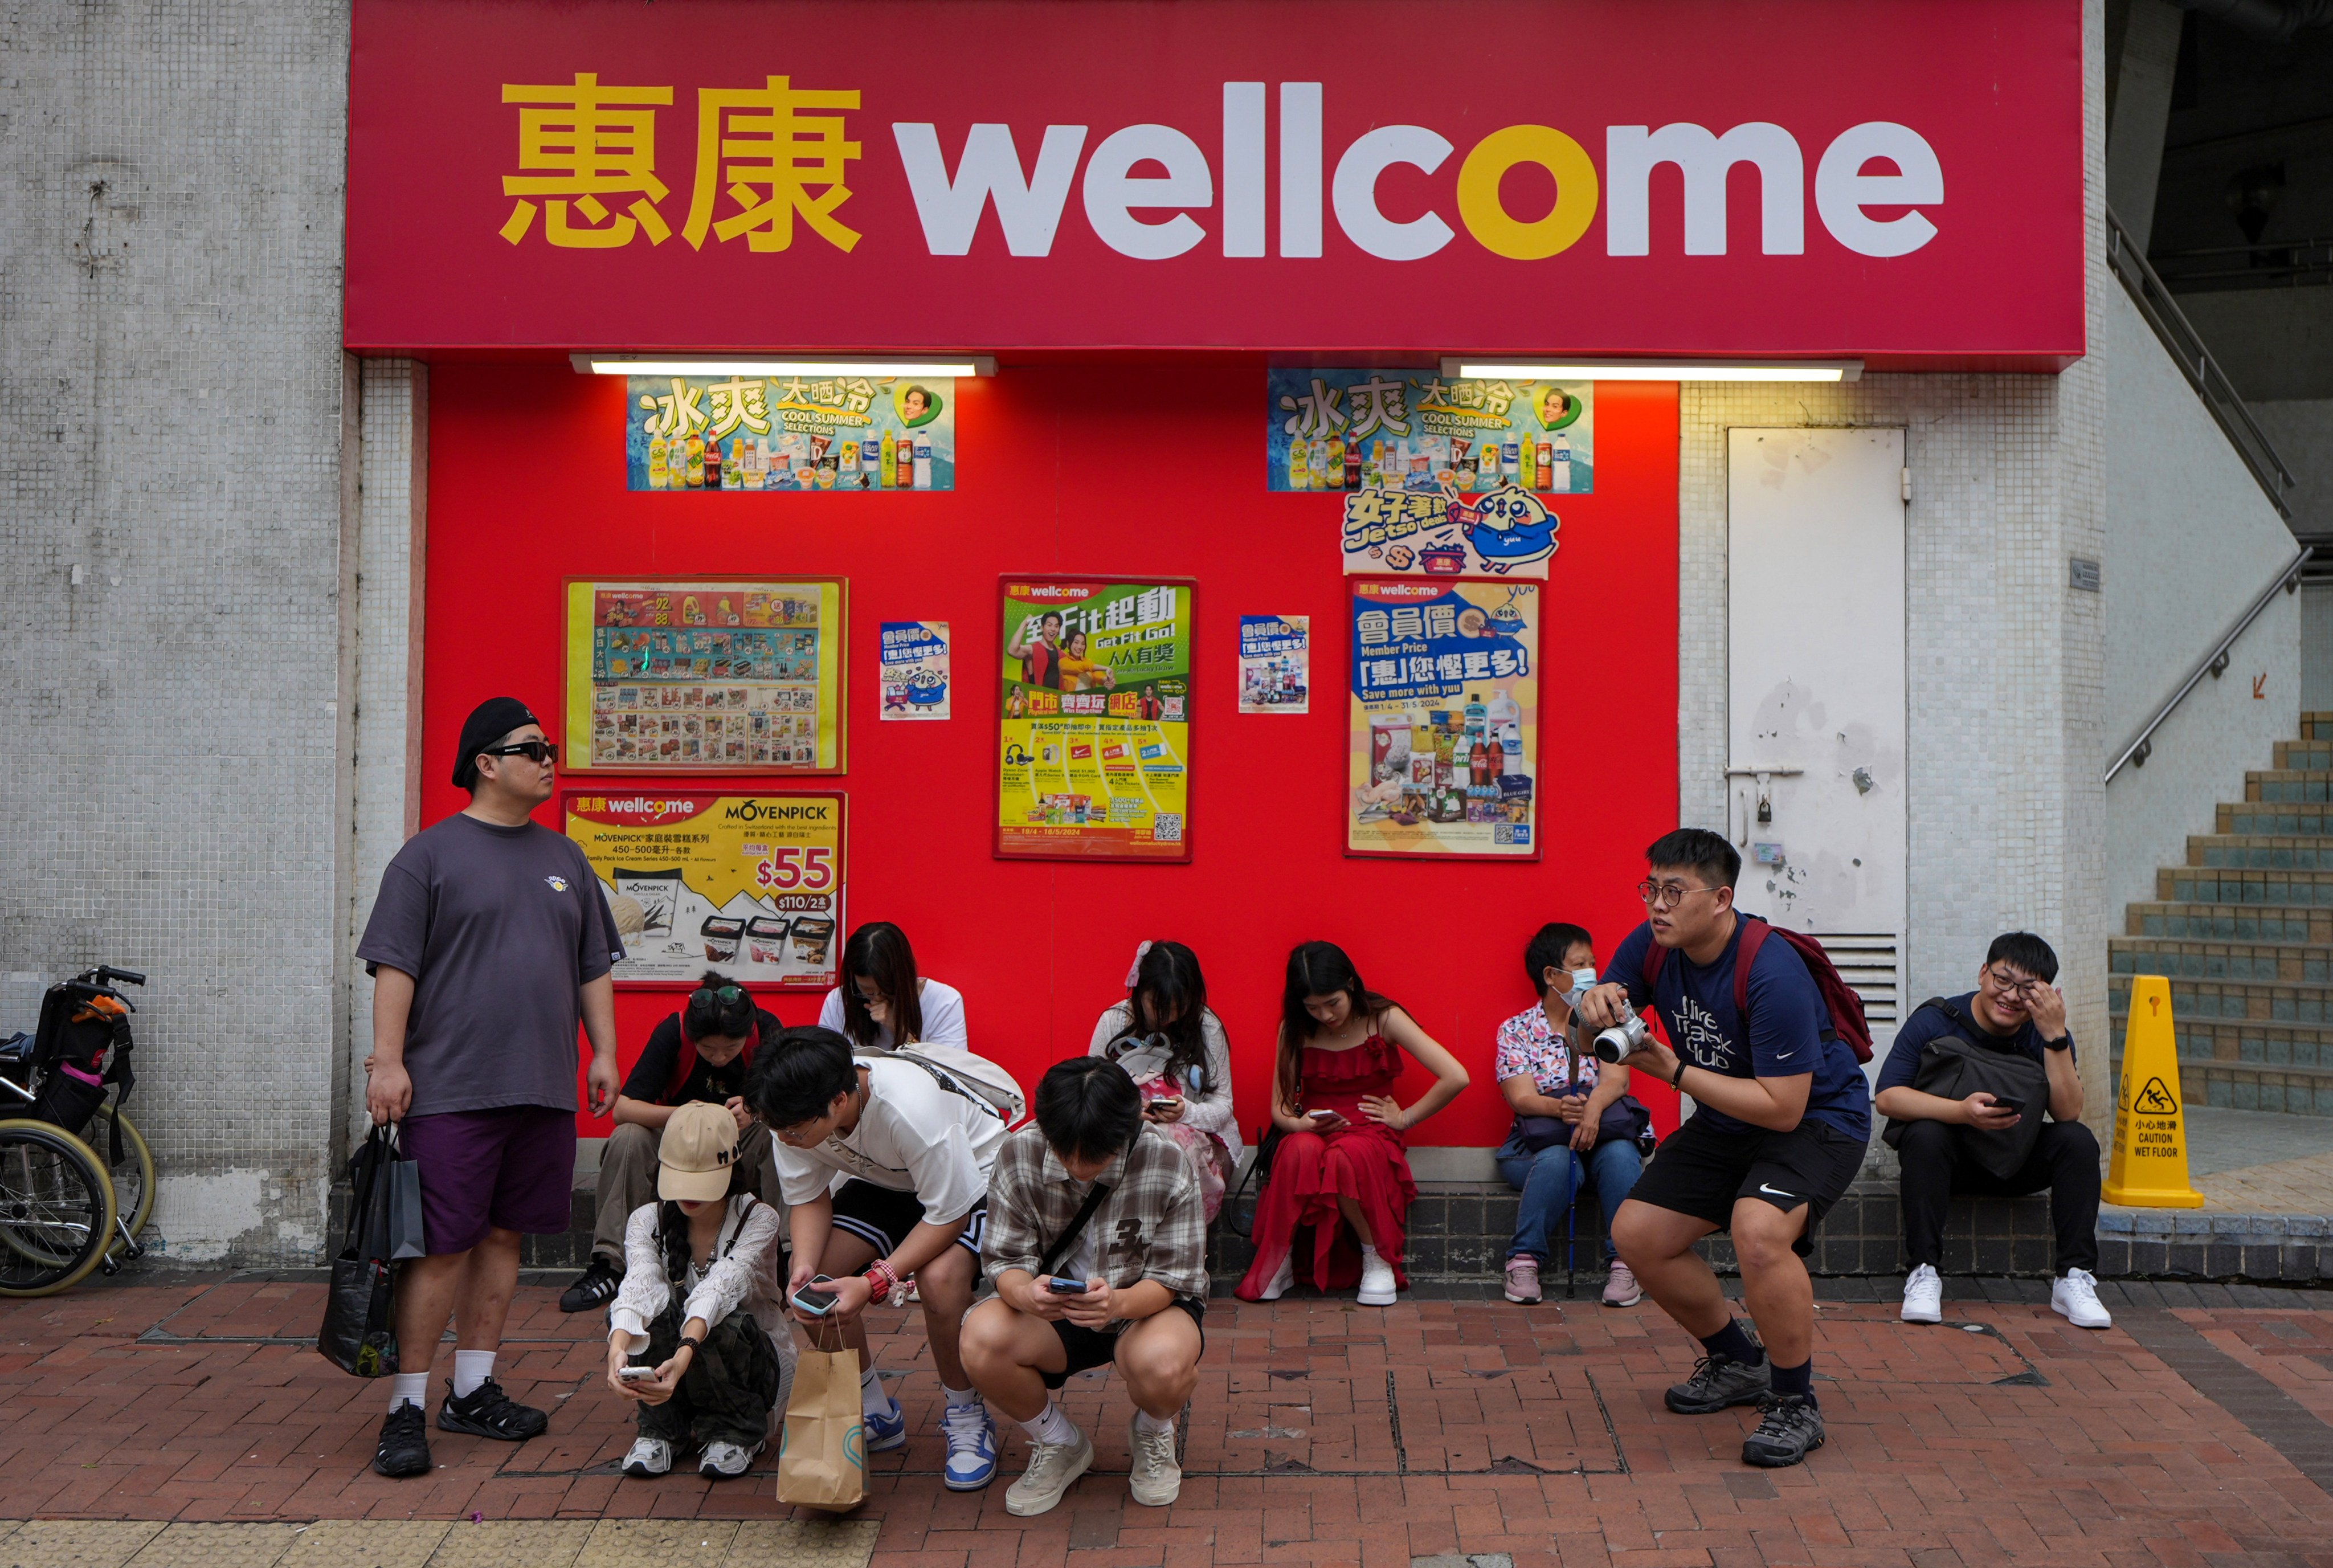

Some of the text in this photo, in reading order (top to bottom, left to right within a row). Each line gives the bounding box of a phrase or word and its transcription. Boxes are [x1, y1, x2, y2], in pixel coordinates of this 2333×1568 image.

[500, 73, 1943, 260] 惠康 wellcome
[781, 376, 876, 413] 大晒冷
[1421, 377, 1514, 415] 大晒冷
[639, 375, 771, 440] 冰爽
[1280, 377, 1411, 443] 冰爽
[782, 411, 864, 427] COOL SUMMER
[1421, 413, 1503, 430] COOL SUMMER
[783, 422, 836, 436] SELECTIONS
[1423, 424, 1474, 438] SELECTIONS
[1345, 514, 1448, 553] Jetso deals
[1503, 537, 1522, 546] yuu
[1010, 585, 1089, 597] 惠康 wellcome
[1359, 584, 1439, 595] 惠康 wellcome
[1507, 585, 1535, 603] yuu
[1356, 604, 1457, 644] 會員價
[1096, 623, 1175, 650] Get Fit Go!
[594, 628, 606, 678] 夏日大晒冷
[1109, 643, 1175, 667] 人人有獎
[1361, 643, 1428, 657] Member Price
[1028, 691, 1137, 710] 門市 齊齊玩 網店
[1362, 684, 1461, 700] Save more with yuu
[577, 797, 694, 813] 惠康 wellcome
[757, 846, 831, 890] $55
[1682, 995, 1718, 1030] Nike
[1672, 1010, 1736, 1055] Track
[1686, 1036, 1730, 1069] Club
[2135, 1120, 2176, 1130] 小心地滑
[2139, 1133, 2172, 1144] CAUTION
[2135, 1147, 2177, 1158] WET FLOOR
